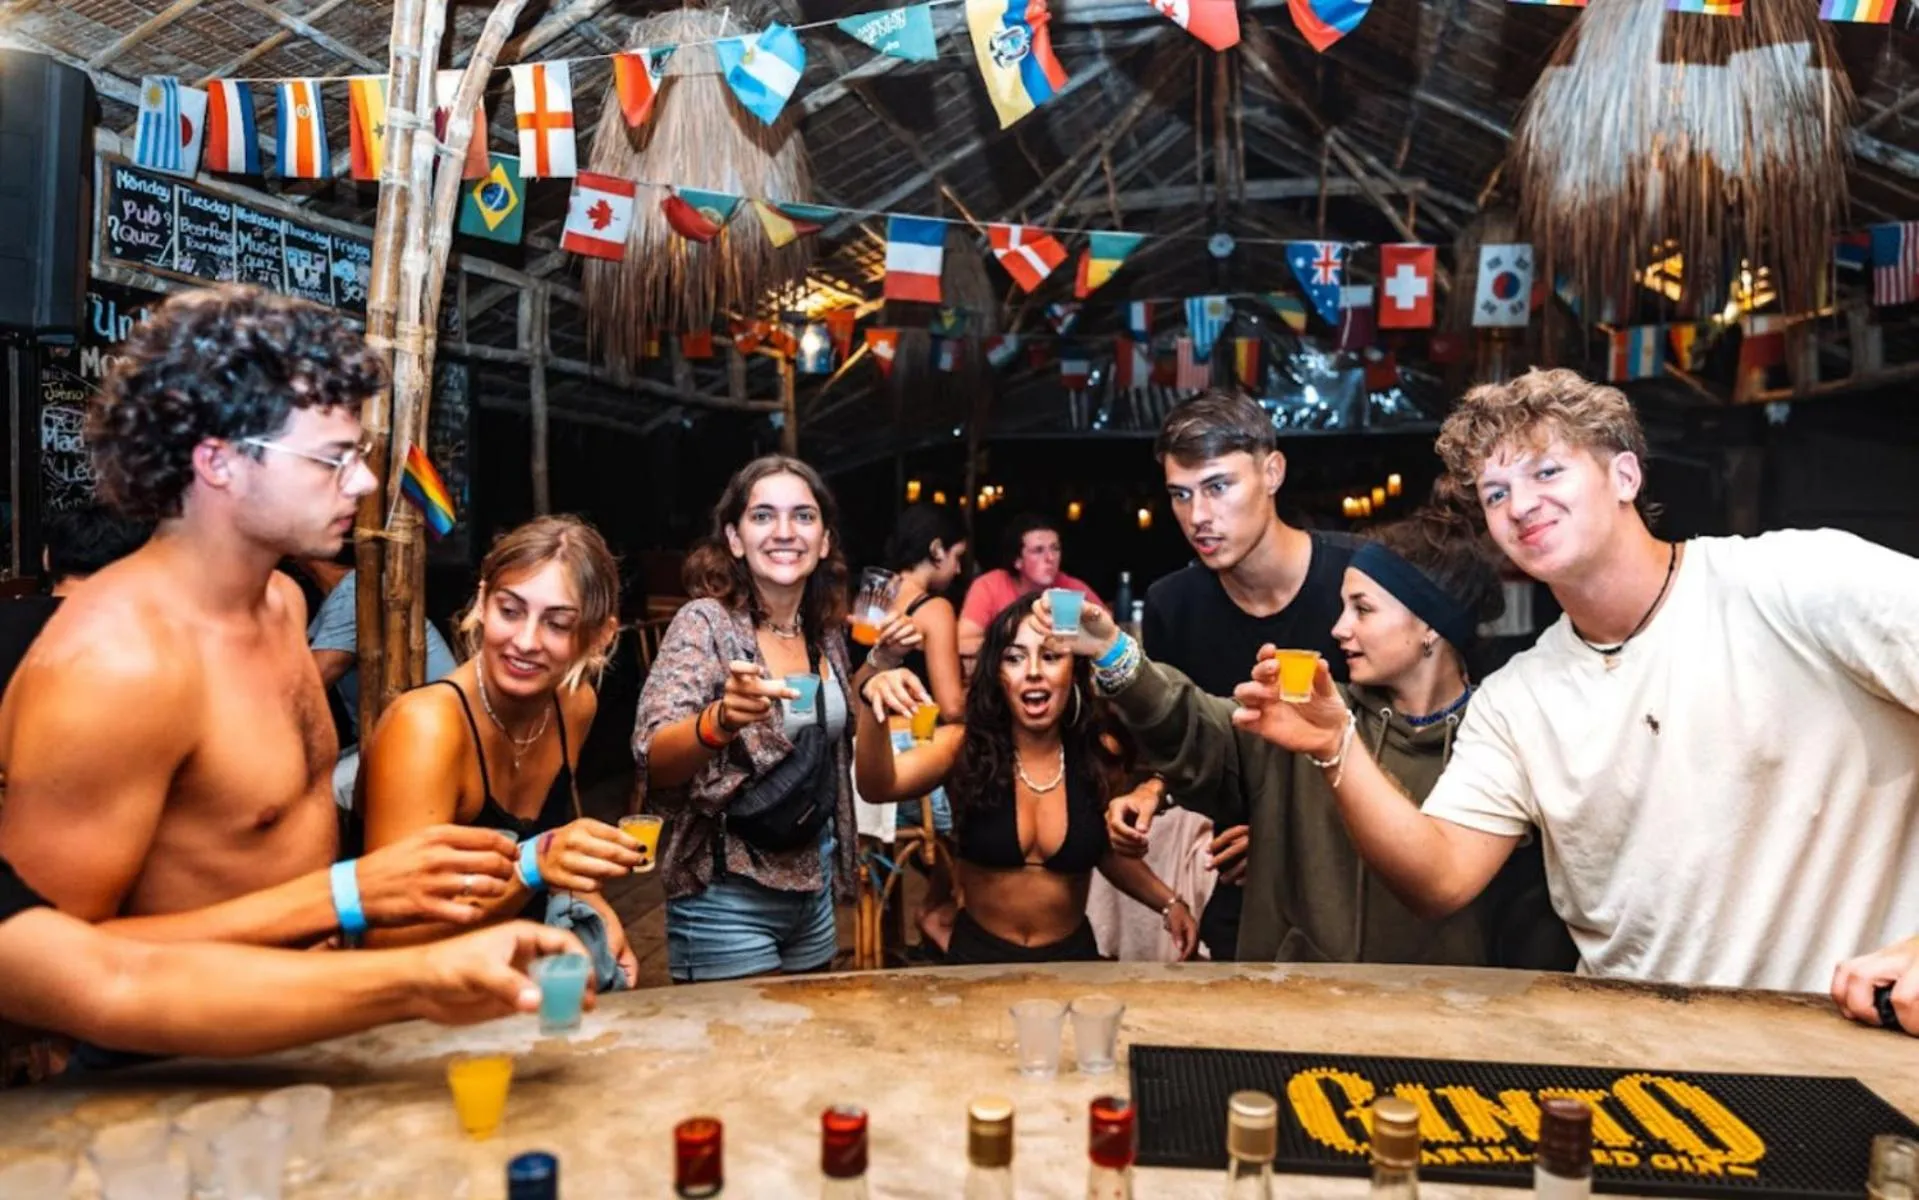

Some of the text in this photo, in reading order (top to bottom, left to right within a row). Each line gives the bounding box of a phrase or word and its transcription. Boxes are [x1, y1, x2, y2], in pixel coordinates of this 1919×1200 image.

[115, 169, 170, 203] Monday
[122, 200, 161, 227] Pub
[178, 188, 230, 221] Tuesday
[1286, 1067, 1766, 1164] GINTO
[1419, 1145, 1534, 1166] ARREL
[1650, 1152, 1723, 1177] GIN
